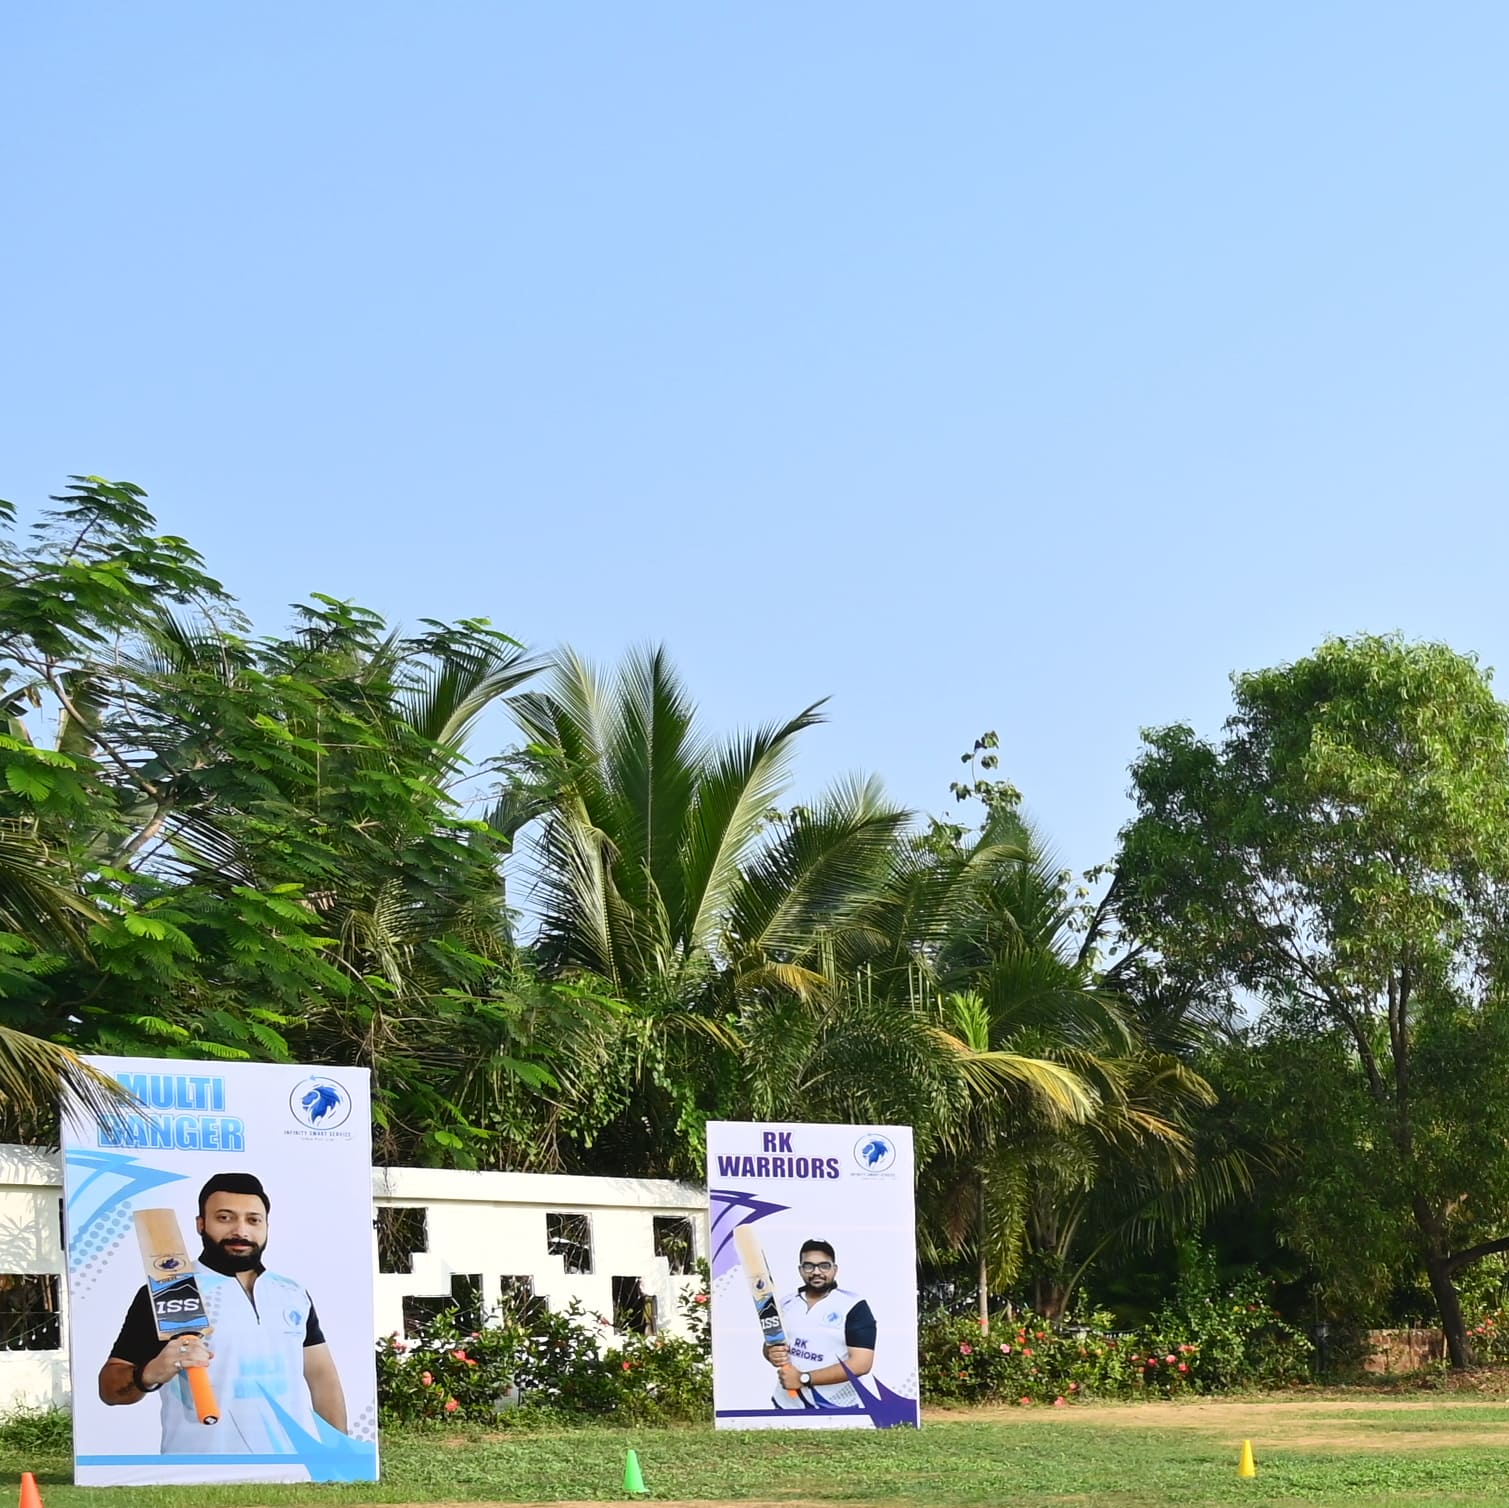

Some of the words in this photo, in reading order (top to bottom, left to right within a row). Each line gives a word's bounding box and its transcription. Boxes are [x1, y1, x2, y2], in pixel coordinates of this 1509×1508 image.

[114, 1072, 225, 1111] MULTI
[762, 1131, 793, 1153] RK
[717, 1155, 840, 1180] WARRIORS
[156, 1298, 200, 1314] ISS
[761, 1316, 780, 1329] ISS
[794, 1338, 808, 1349] RK
[787, 1345, 824, 1362] ARRIORS
